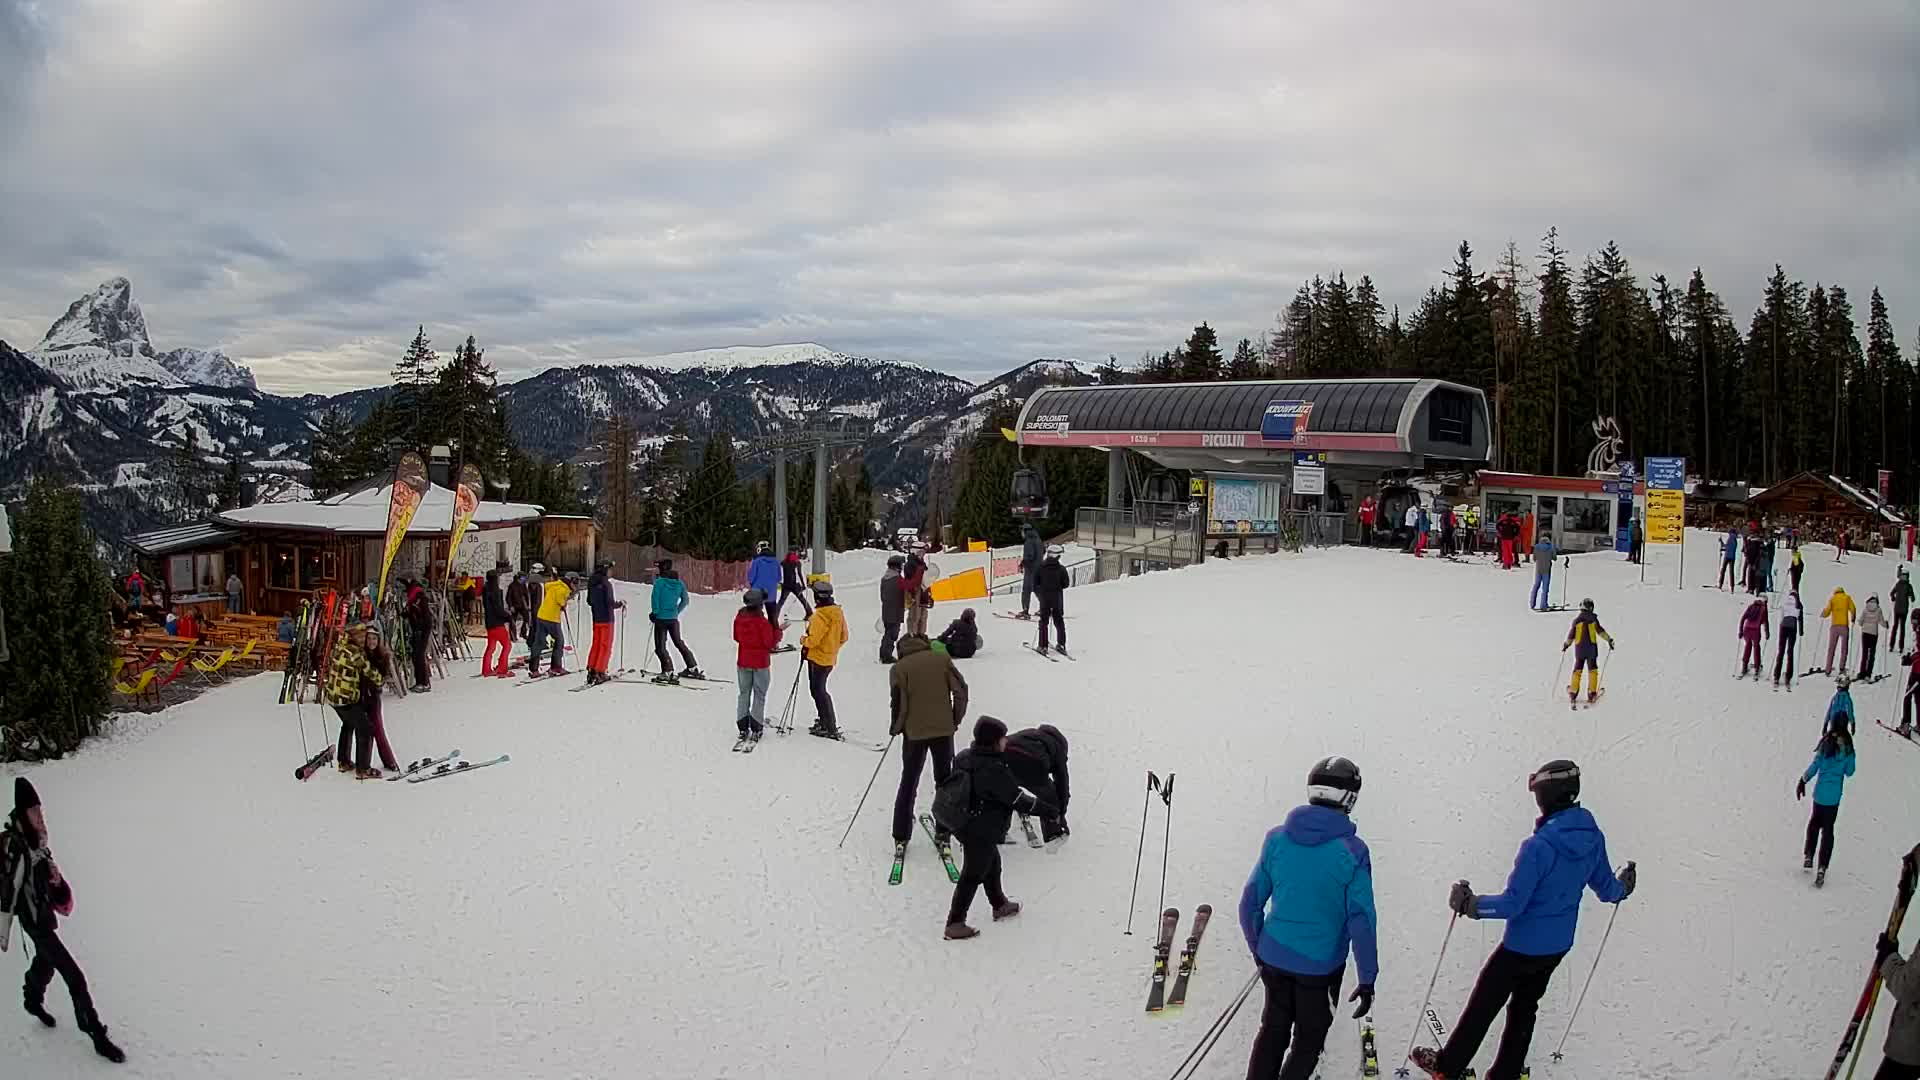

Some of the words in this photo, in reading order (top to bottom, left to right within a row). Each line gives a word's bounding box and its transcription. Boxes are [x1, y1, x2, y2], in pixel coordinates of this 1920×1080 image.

[1036, 414, 1069, 422] DOLOMITI
[1026, 422, 1059, 430] SUPERSKI
[1202, 434, 1245, 447] PICULIN
[1426, 1009, 1446, 1035] HEAD
